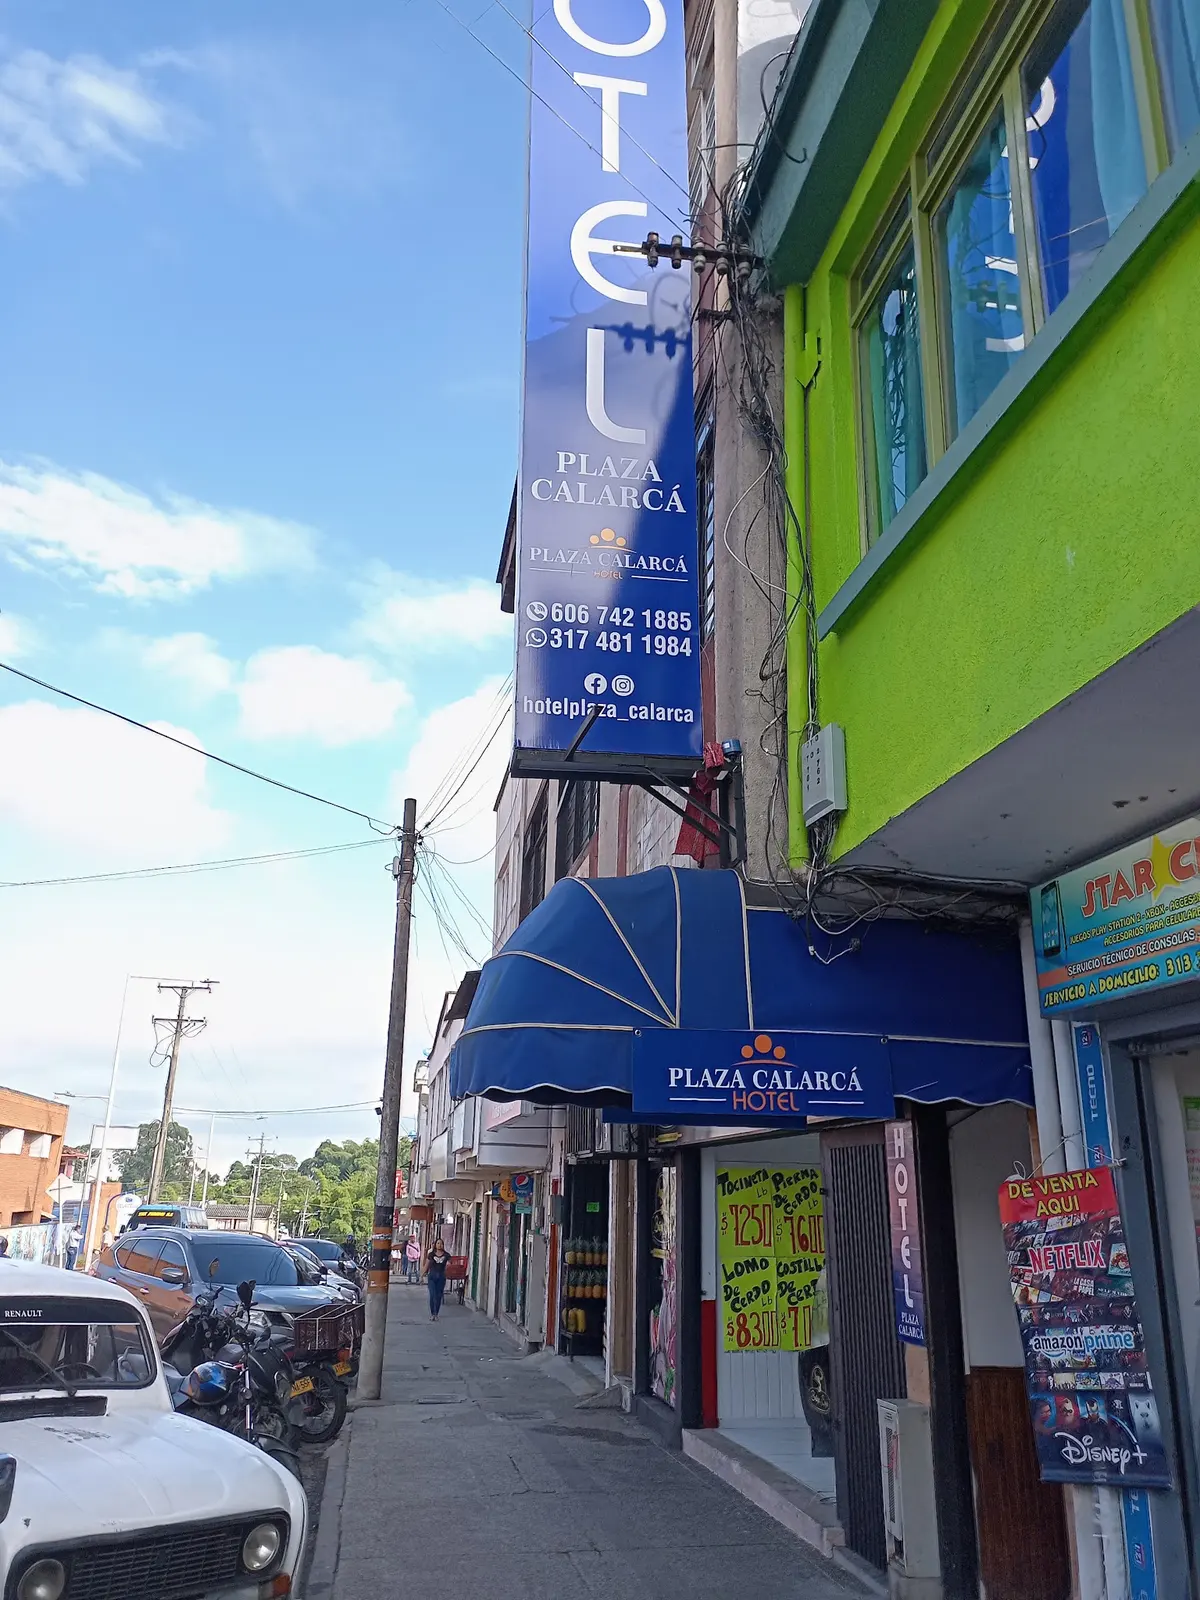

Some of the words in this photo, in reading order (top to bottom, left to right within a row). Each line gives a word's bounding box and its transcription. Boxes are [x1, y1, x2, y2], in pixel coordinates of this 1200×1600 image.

[556, 451, 663, 483] PLAZA
[531, 478, 687, 513] CALARCÁ
[529, 547, 592, 565] PLAZA
[598, 553, 688, 573] CALARCÁ
[594, 570, 623, 580] HOTEL
[551, 602, 589, 624] 606
[596, 605, 635, 628] 742
[641, 608, 692, 632] 1885
[550, 628, 589, 650] 317
[595, 631, 632, 653] 481
[641, 634, 692, 657] 1984
[1081, 859, 1156, 918] STAR
[1169, 834, 1200, 883] C
[1070, 931, 1091, 946] JUEGOS
[1092, 926, 1108, 937] PLAY
[1108, 916, 1136, 932] STATION
[1136, 911, 1142, 922] 2
[1145, 905, 1165, 919] XBOX
[1103, 926, 1145, 946] ACCESORIOS
[1145, 919, 1164, 934] PARA
[1067, 958, 1101, 977] SERVICIO
[1136, 945, 1148, 956] DE
[1148, 929, 1196, 953] CONSOLAS
[1044, 985, 1086, 1008] SERVICIO
[1088, 980, 1097, 996] A
[1098, 964, 1160, 993] DOMICILIO:
[668, 1067, 747, 1089] PLAZA
[752, 1066, 863, 1092] CALARCÁ
[1086, 1064, 1099, 1121] TECNO
[733, 1091, 801, 1112] HOTEL
[1008, 1182, 1035, 1199] DE
[1036, 1171, 1099, 1196] VENTA
[893, 1128, 914, 1308] HOTEL
[1036, 1195, 1080, 1217] AQUI
[722, 1257, 769, 1282] LOMO
[1028, 1240, 1106, 1275] NETFLIX
[4, 1309, 43, 1318] RENAULT
[901, 1311, 920, 1326] PLAZA
[898, 1324, 924, 1340] CALARCÁ
[1033, 1335, 1083, 1351] amazon
[1083, 1329, 1134, 1352] prime
